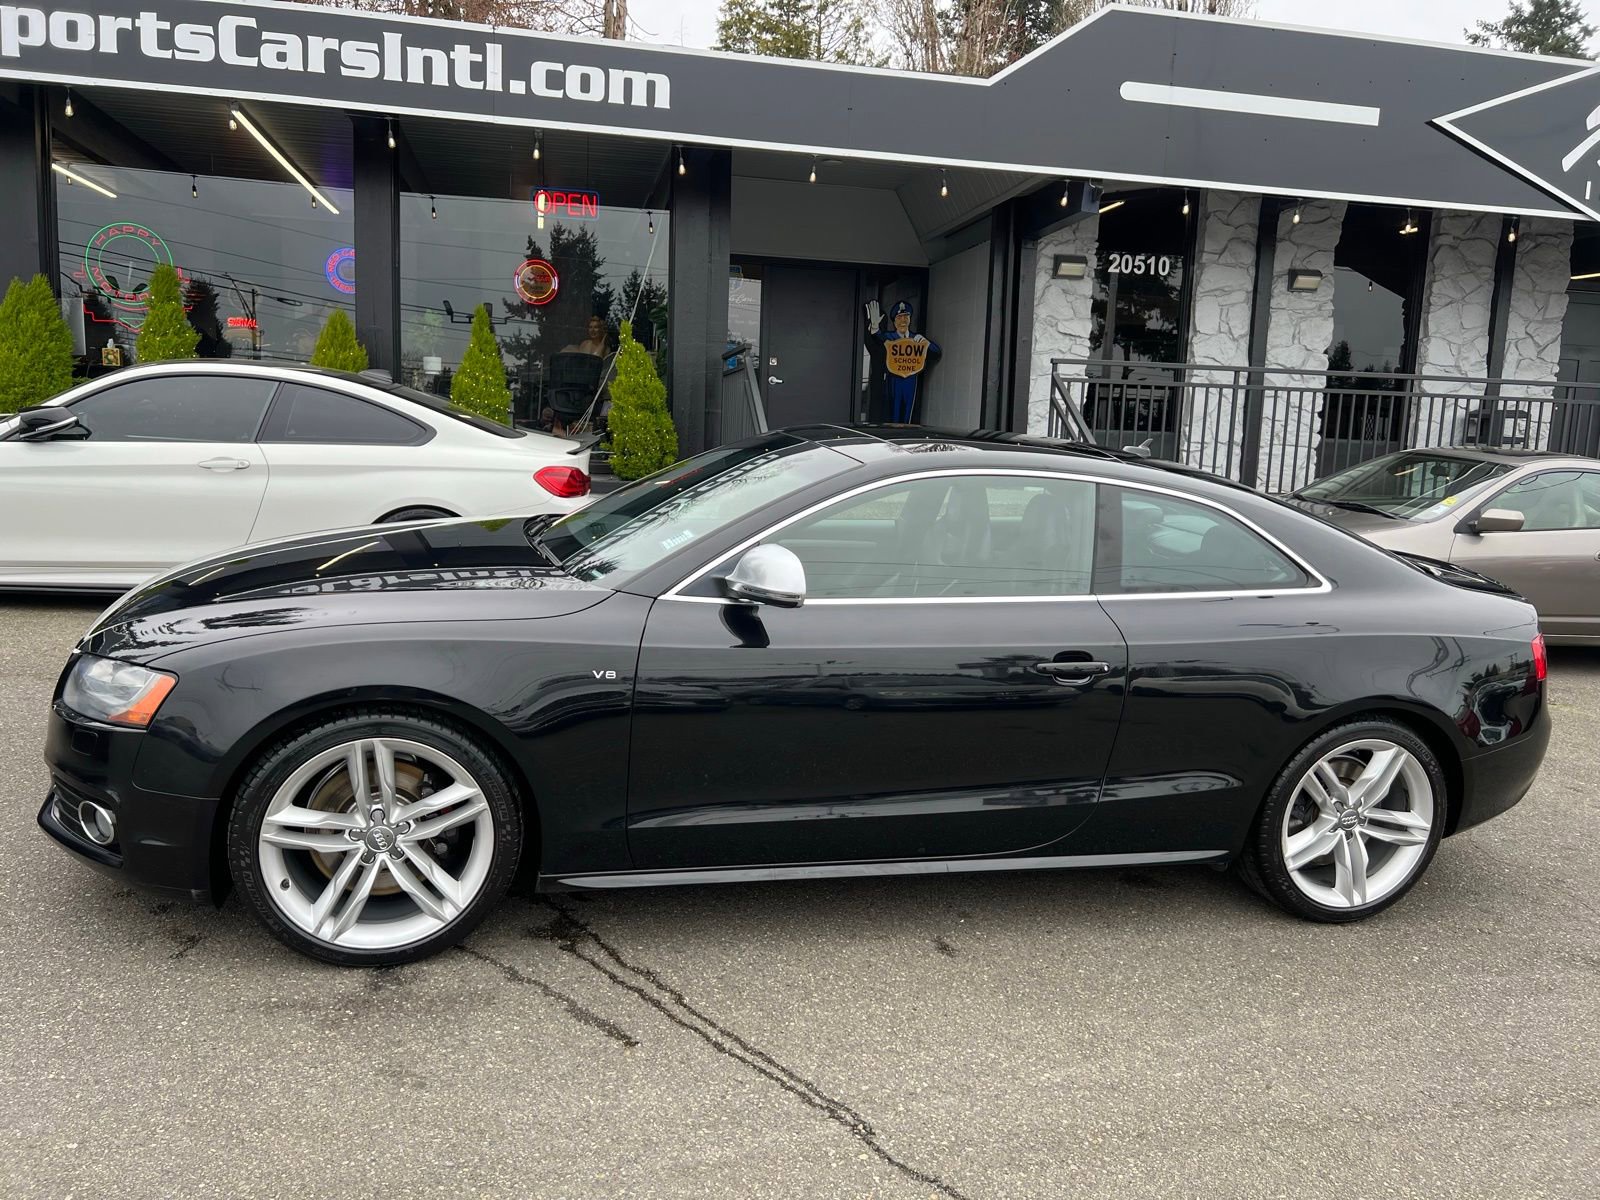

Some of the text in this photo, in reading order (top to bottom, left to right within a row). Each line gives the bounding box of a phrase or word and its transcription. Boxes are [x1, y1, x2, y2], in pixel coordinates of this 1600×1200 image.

[0, 5, 672, 109] portsCarsIntl.com
[534, 190, 597, 217] OPEN
[95, 225, 161, 246] HAPPY
[1107, 253, 1170, 276] 20510
[891, 344, 924, 357] SLOW
[893, 357, 921, 365] SCHOOL
[592, 669, 617, 679] V8
